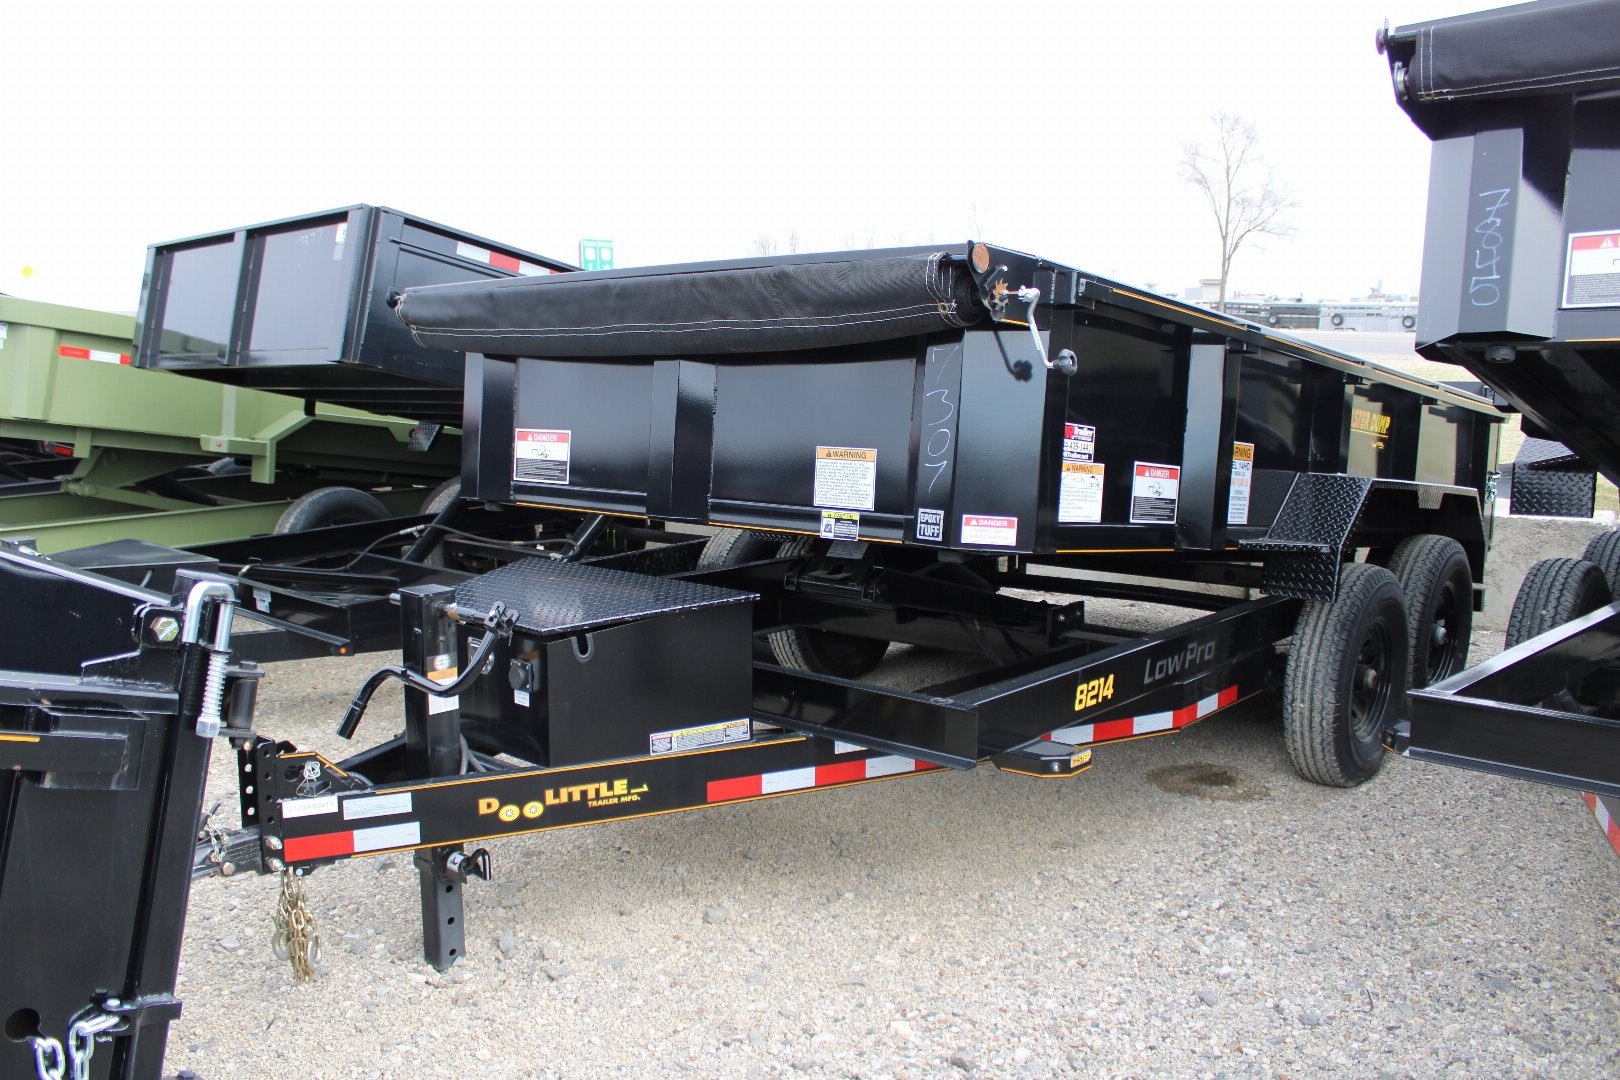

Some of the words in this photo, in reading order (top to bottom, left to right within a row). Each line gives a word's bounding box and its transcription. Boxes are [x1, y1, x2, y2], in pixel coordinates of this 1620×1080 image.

[534, 433, 558, 442] DANGER
[833, 450, 867, 460] WARNING
[1071, 464, 1094, 473] WARNING
[1150, 469, 1170, 478] DANGER
[920, 512, 941, 524] EPOXY
[978, 519, 1008, 527] DANGER
[920, 523, 940, 537] TUFF
[1074, 674, 1114, 712] 8214
[588, 796, 619, 808] TRAILER
